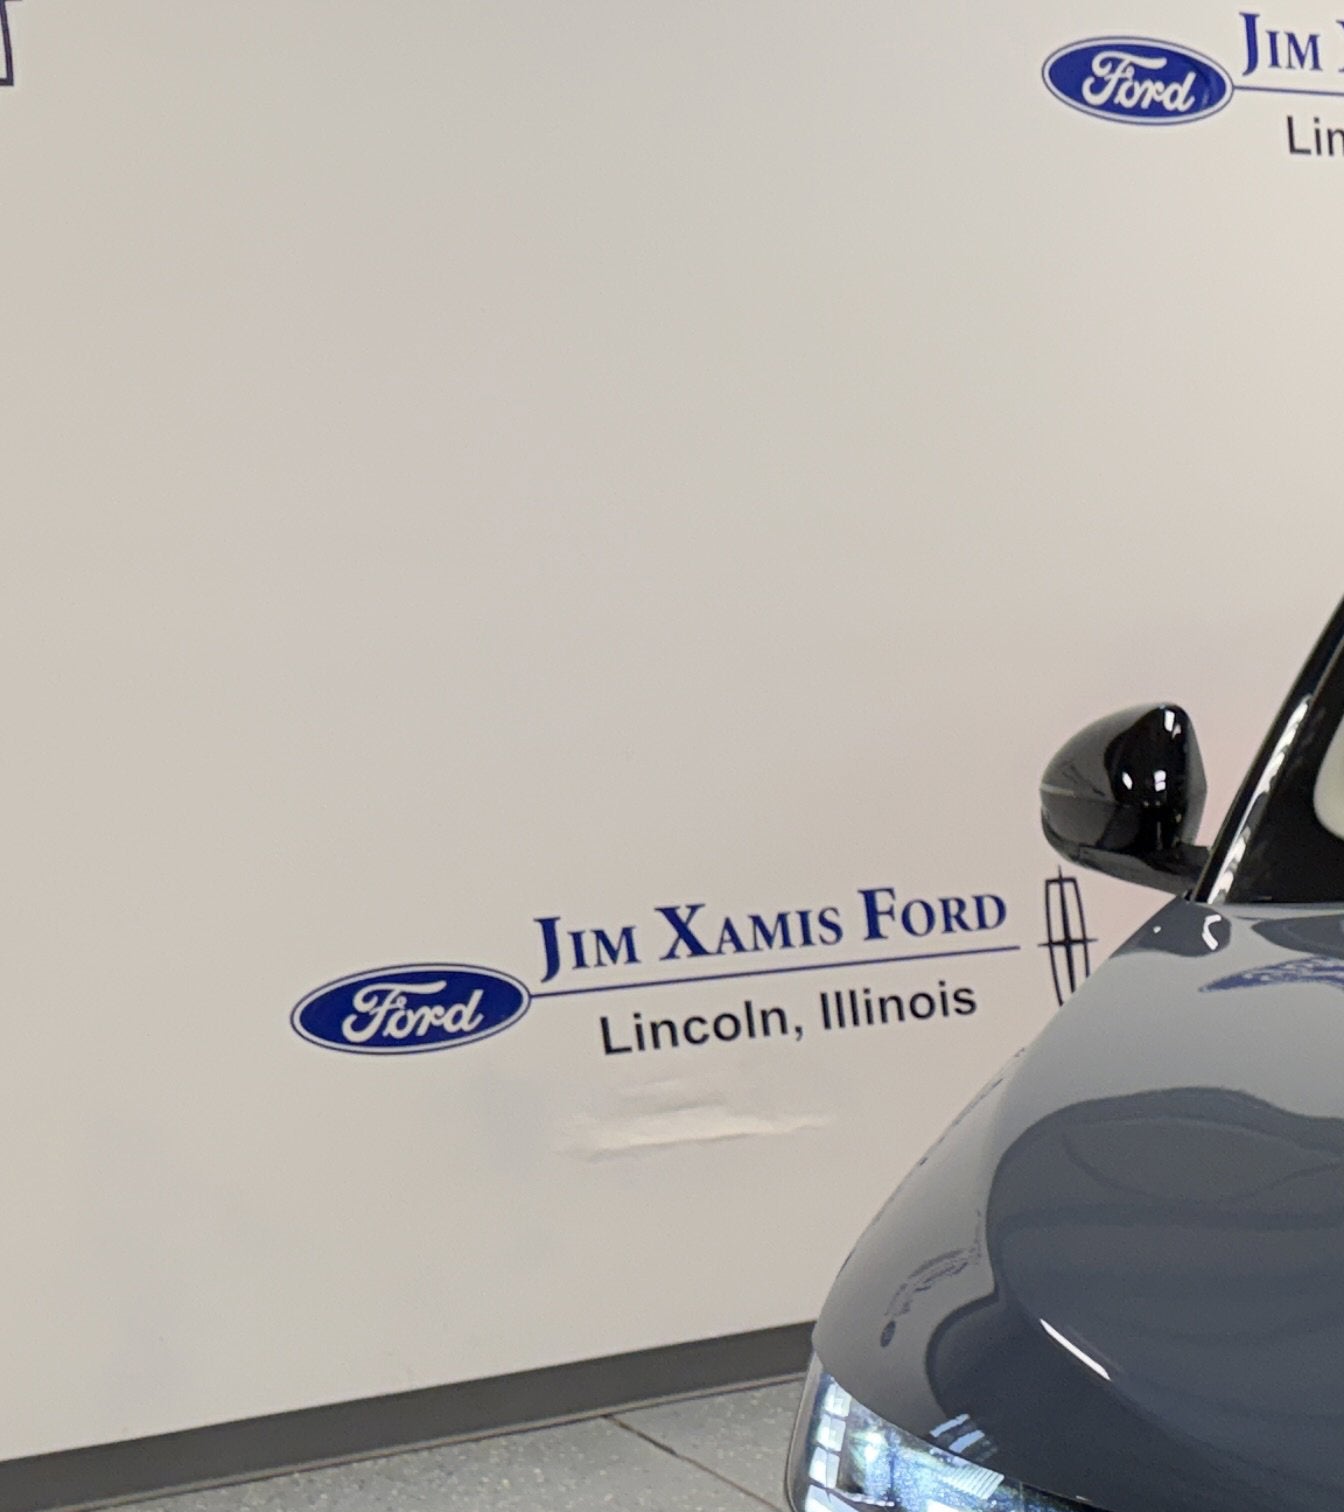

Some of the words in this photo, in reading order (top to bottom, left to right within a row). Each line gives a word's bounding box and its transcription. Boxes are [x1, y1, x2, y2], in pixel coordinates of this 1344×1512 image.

[1239, 12, 1320, 77] JIM
[1082, 50, 1195, 114] Ford
[533, 916, 638, 983] JIM
[655, 903, 844, 960] XAMIS
[856, 886, 1007, 943] FORD
[341, 981, 484, 1043] Ford
[600, 999, 804, 1055] Lincoln,
[820, 979, 977, 1031] Illinois
